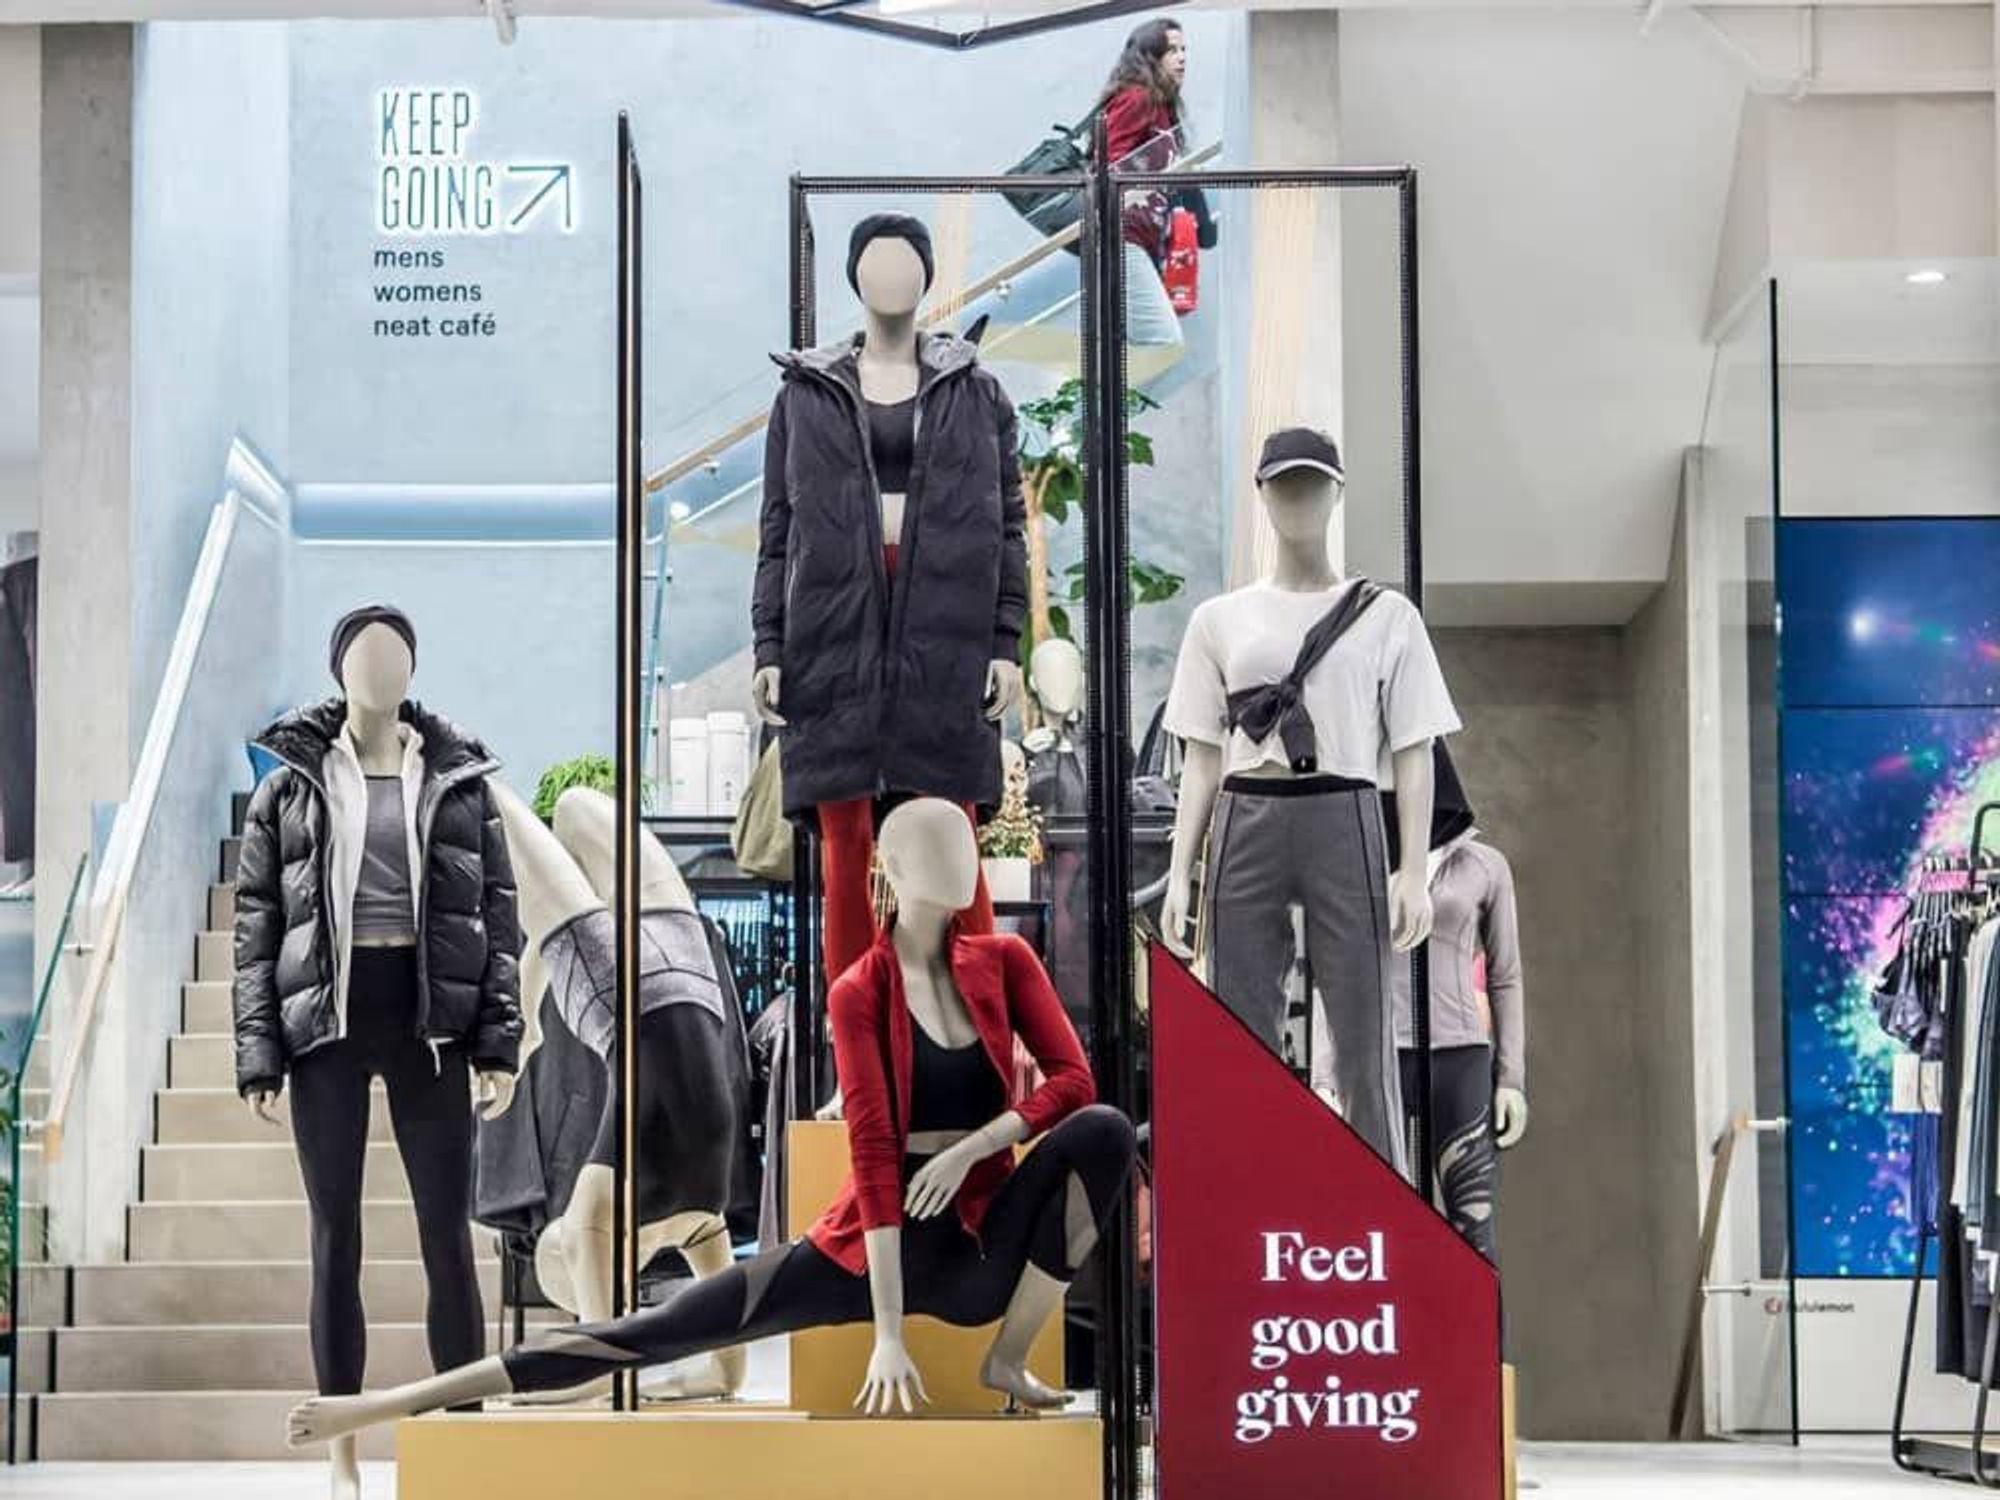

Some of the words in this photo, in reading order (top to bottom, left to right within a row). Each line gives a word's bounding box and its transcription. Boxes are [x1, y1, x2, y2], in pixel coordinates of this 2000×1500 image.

[381, 92, 470, 155] KEEP
[382, 165, 493, 230] GOING
[373, 250, 445, 268] mens
[373, 283, 482, 302] womens
[373, 315, 431, 336] neat
[439, 311, 497, 336] café
[1261, 1231, 1388, 1281] Feel
[1251, 1303, 1399, 1369] good
[1235, 1375, 1421, 1443] giving
